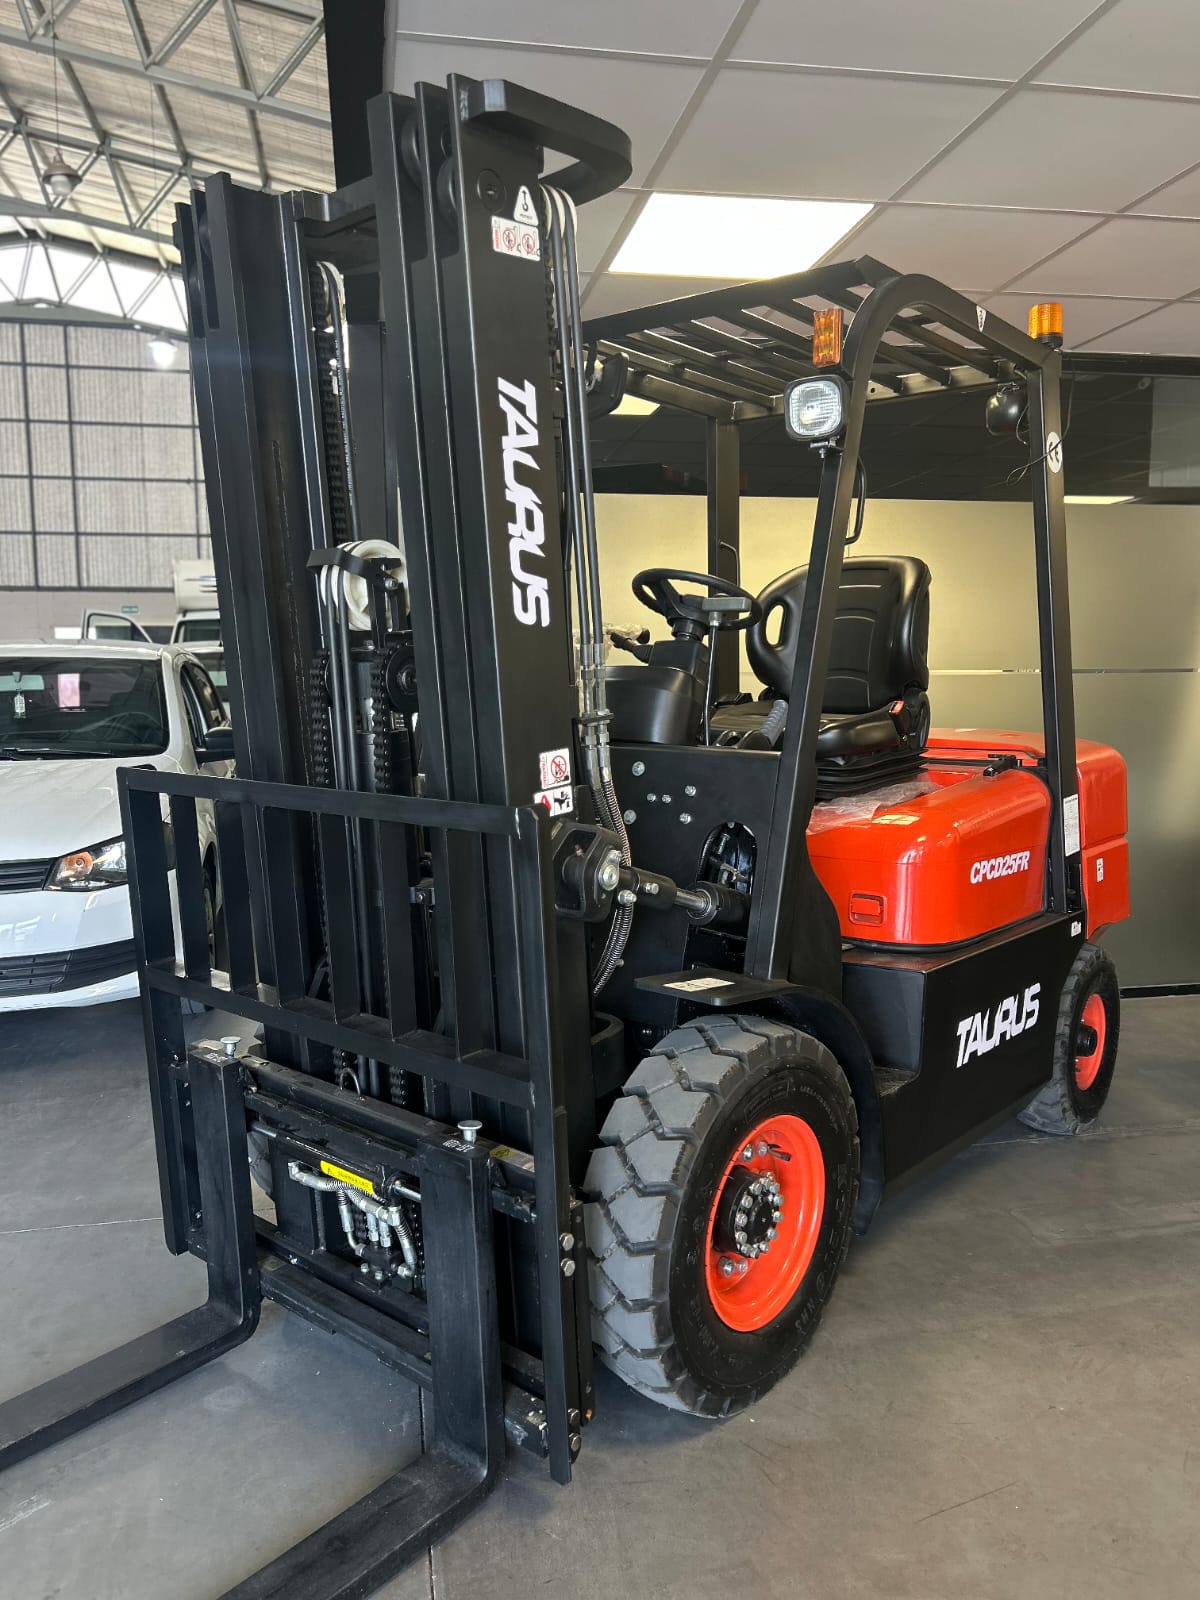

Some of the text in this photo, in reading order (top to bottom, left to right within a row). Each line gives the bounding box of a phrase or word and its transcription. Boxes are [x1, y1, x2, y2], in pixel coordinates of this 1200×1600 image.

[498, 376, 550, 628] TAURUS
[970, 851, 1030, 884] CPCD25FR
[956, 982, 1041, 1068] TAURUS
